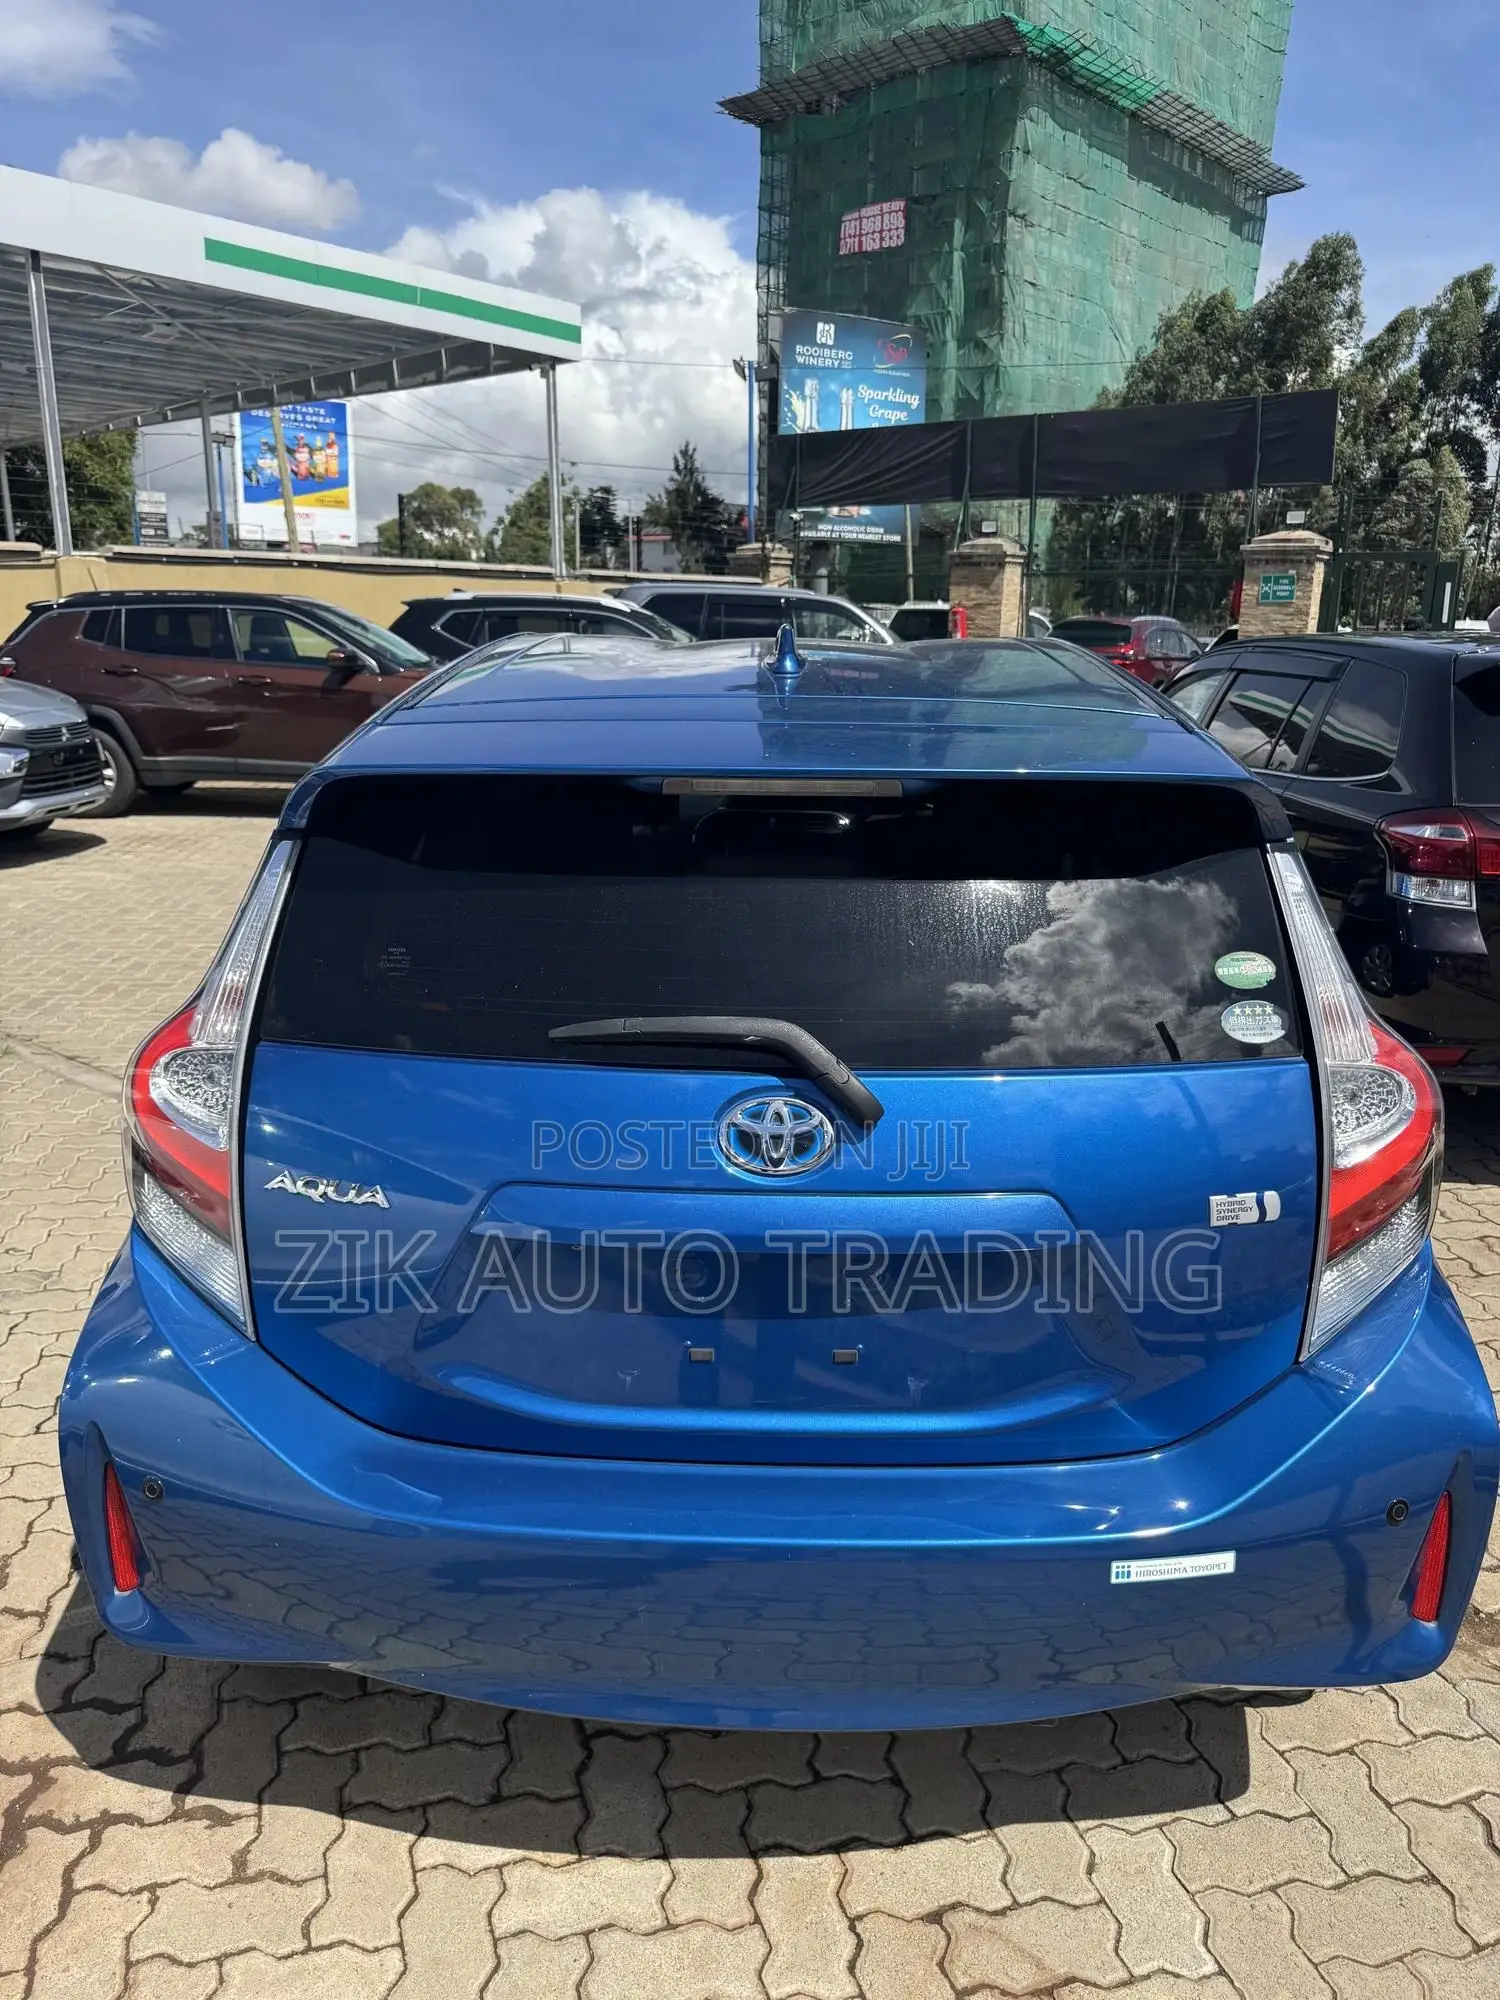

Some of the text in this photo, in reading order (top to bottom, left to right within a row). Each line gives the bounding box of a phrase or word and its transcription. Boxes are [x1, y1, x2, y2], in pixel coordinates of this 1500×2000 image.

[860, 232, 880, 252] 163
[882, 228, 905, 249] 333
[795, 344, 853, 361] ROOIBERG
[795, 355, 841, 369] WINERY
[857, 384, 920, 409] Sparkling
[305, 414, 336, 424] GREAT
[869, 404, 908, 425] Grape
[263, 1170, 390, 1209] AQUA
[1215, 1200, 1246, 1208] HYBRID
[1216, 1206, 1254, 1215] SYNERGY
[1216, 1214, 1241, 1222] DRIVE
[1135, 1566, 1188, 1578] HIROSHIMA
[1190, 1561, 1229, 1573] TOYOPET
